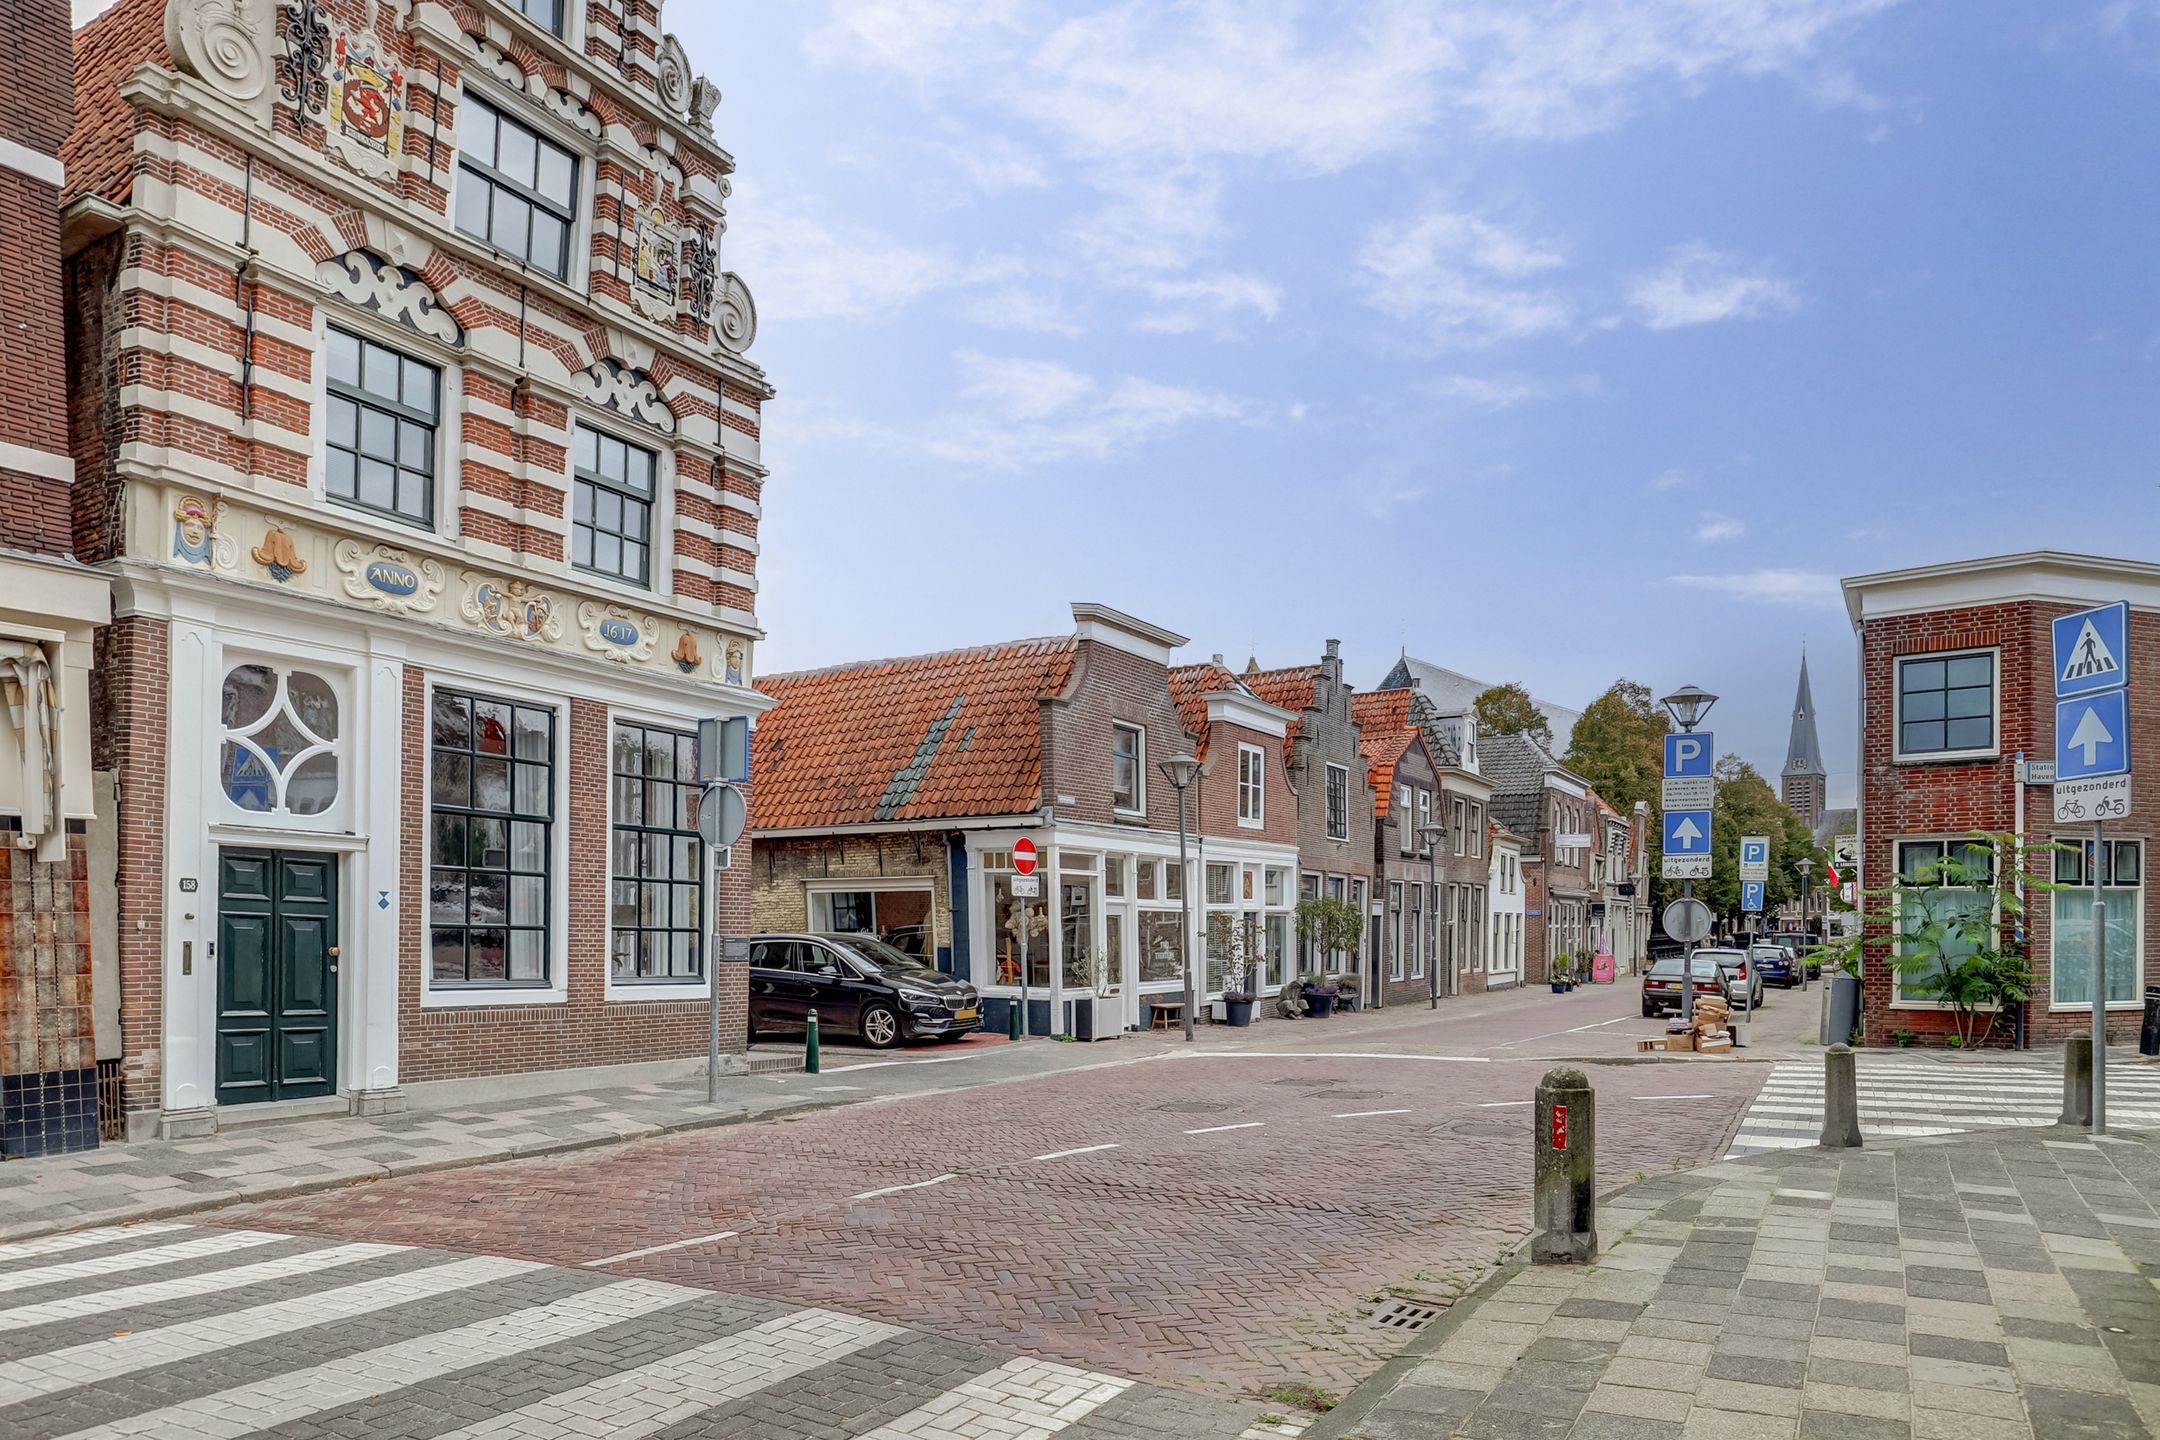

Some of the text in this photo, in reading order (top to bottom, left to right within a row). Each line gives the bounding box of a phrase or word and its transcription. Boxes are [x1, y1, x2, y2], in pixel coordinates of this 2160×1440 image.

[370, 568, 414, 588] ANNO
[1675, 739, 1701, 772] P
[2056, 779, 2126, 795] uitgezonderd
[1748, 846, 1760, 860] P
[182, 880, 196, 890] 158
[1747, 884, 1759, 899] P
